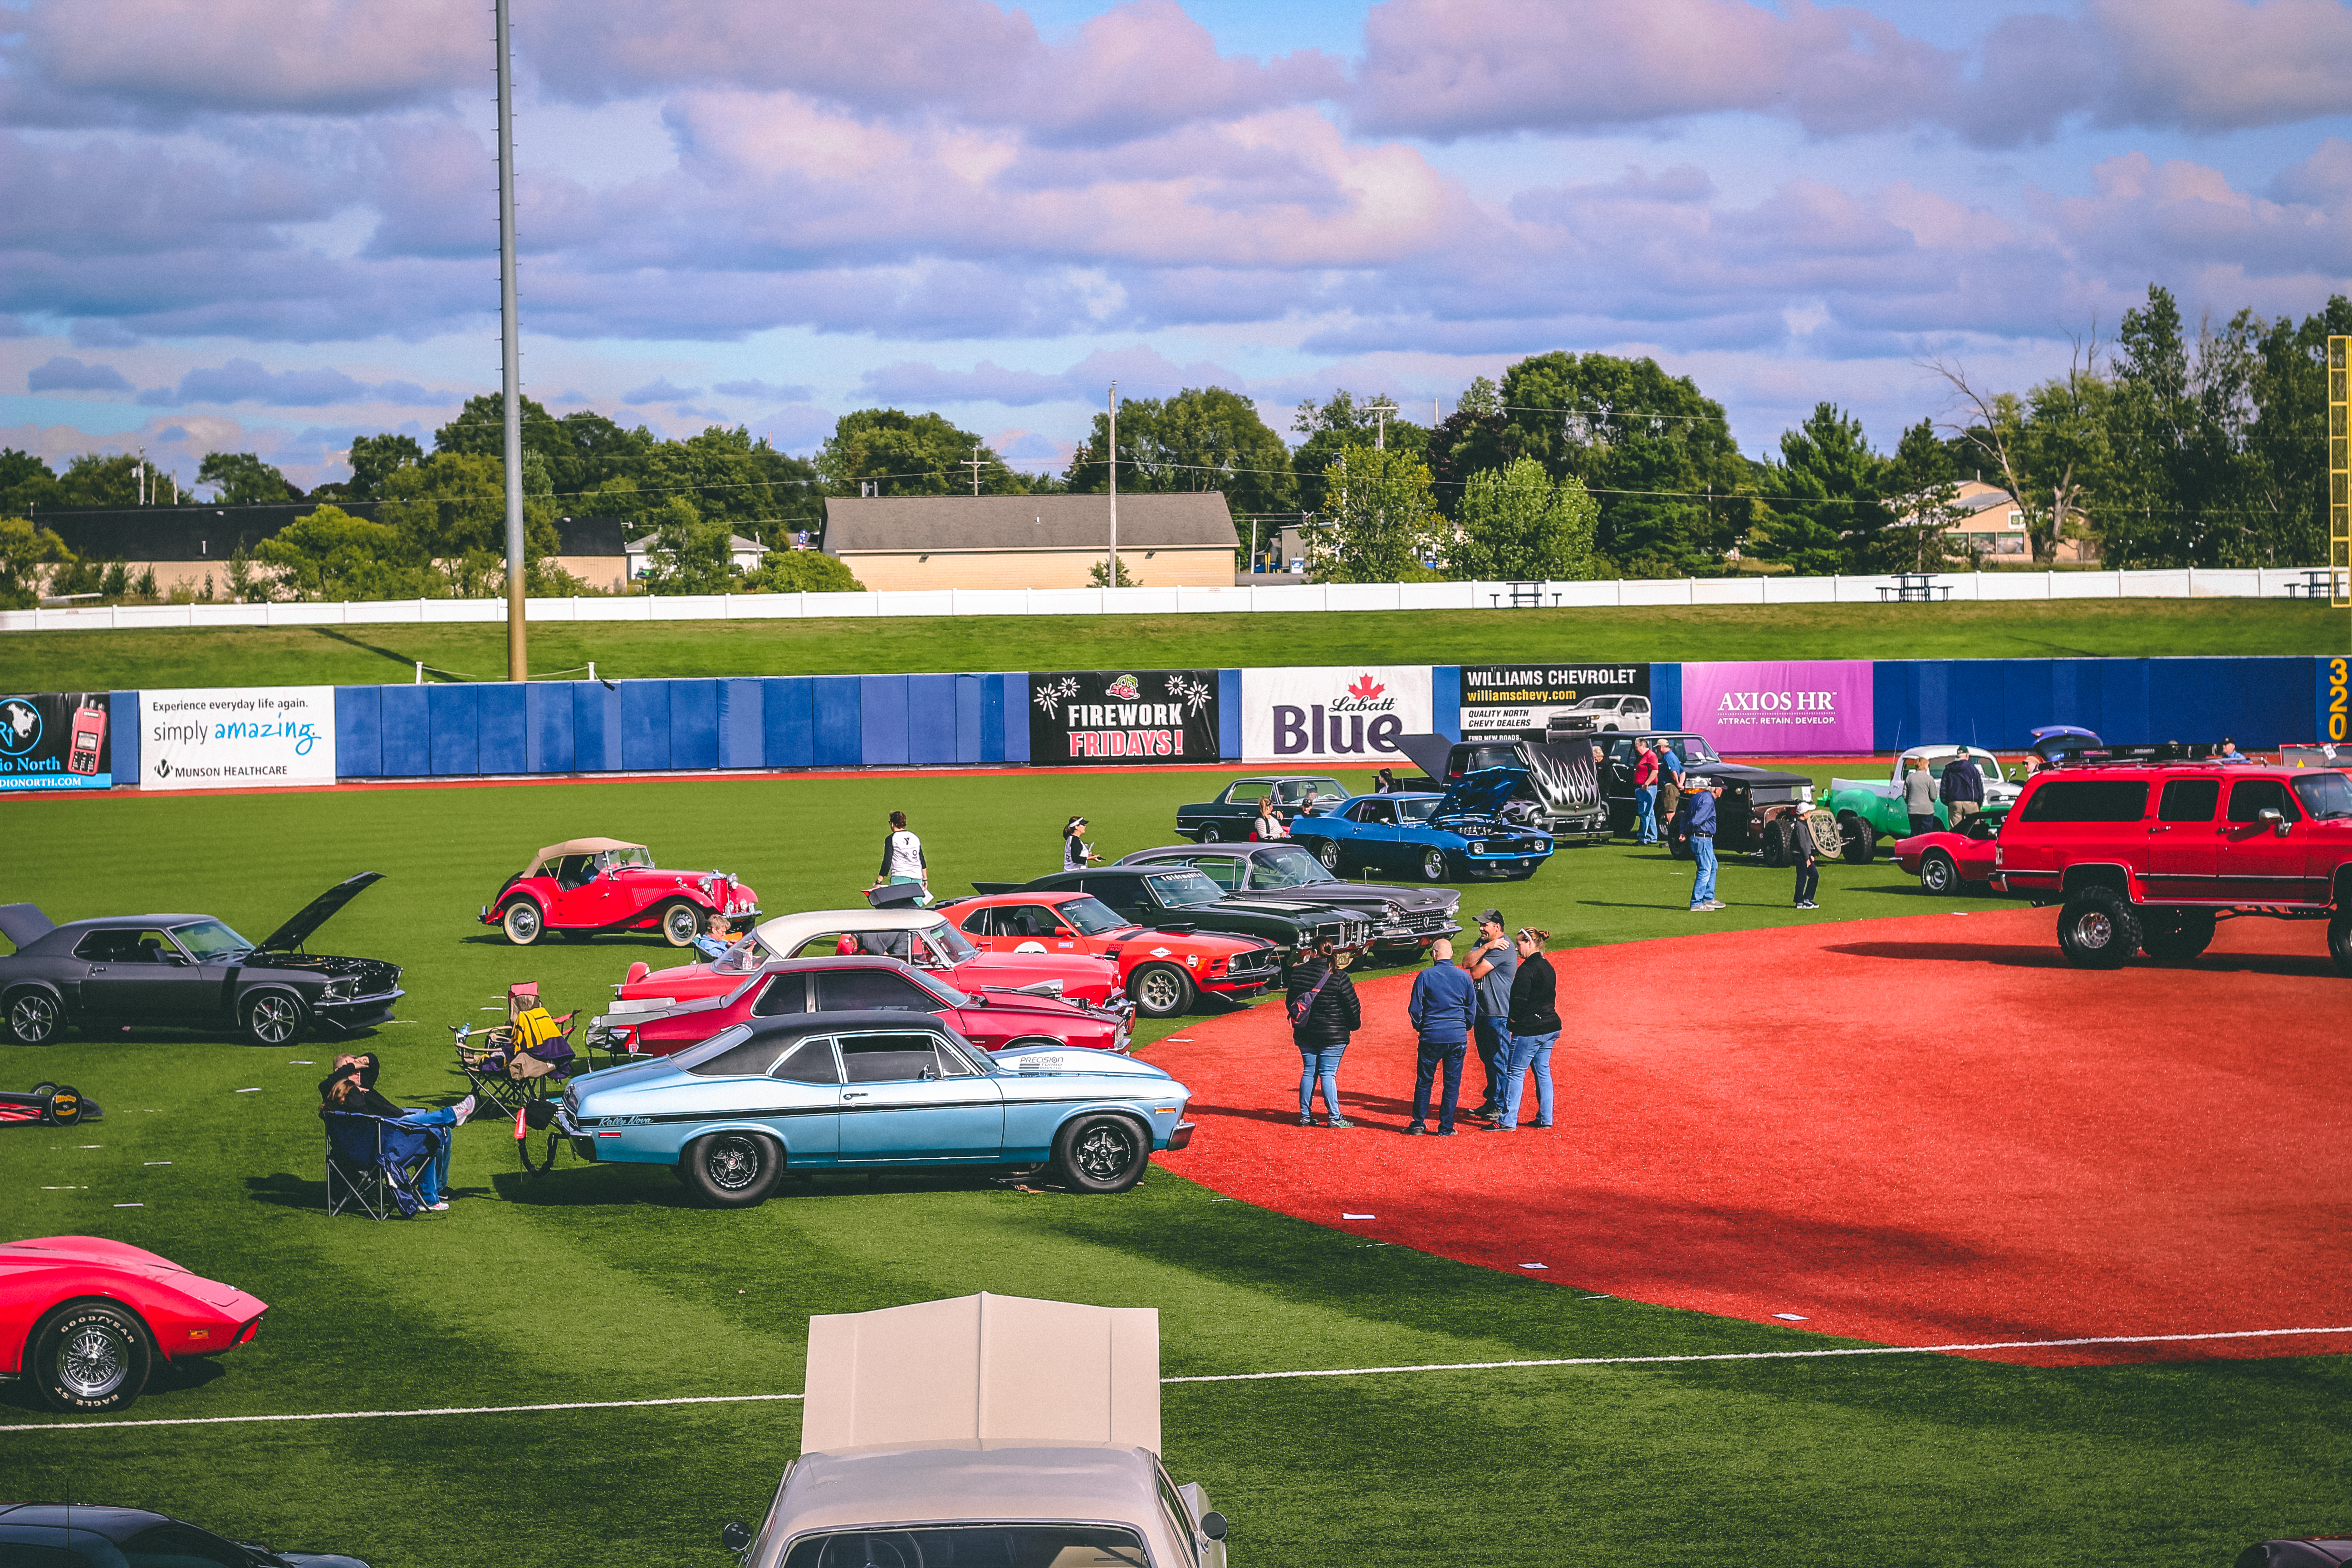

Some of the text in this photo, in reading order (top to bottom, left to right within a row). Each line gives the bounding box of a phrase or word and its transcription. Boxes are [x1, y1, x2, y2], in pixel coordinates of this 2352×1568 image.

[1467, 669, 1637, 686] WILLIAMS CHEVROLET
[1328, 696, 1395, 712] Labatt
[1467, 689, 1576, 702] williamschevy.com
[1717, 692, 1835, 711] AXIOS HR
[2328, 658, 2348, 740] 320
[153, 698, 308, 713] Experience everyday life again.
[1068, 703, 1183, 727] FIREWORK
[154, 712, 322, 755] simply amazing.
[1272, 704, 1402, 754] Blue
[1067, 729, 1184, 757] FRIDAYS!
[17, 756, 61, 771] North
[175, 765, 288, 777] MUNSON HEALTHCARE
[598, 1116, 654, 1127] Rally Nova
[61, 1315, 134, 1343] GOODYEAR
[54, 1387, 119, 1406] EAGLE ST
